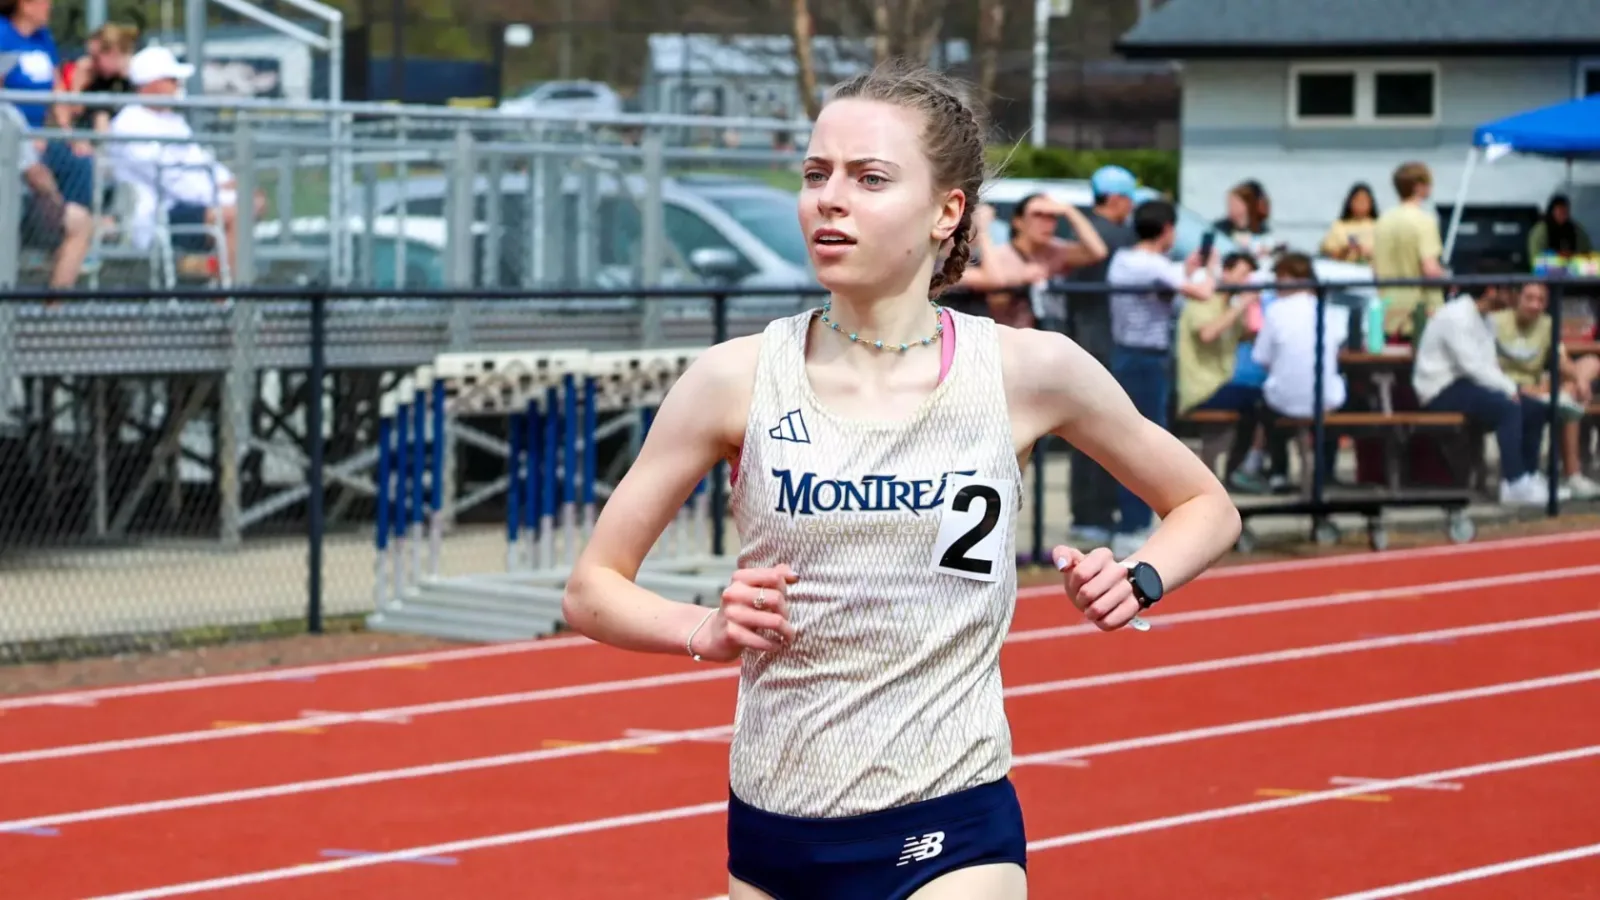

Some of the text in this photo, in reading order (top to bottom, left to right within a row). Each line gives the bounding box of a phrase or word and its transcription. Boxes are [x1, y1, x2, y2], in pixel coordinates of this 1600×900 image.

[772, 468, 977, 518] MONTRE
[804, 523, 935, 536] COLLEGE
[938, 484, 1002, 575] 2
